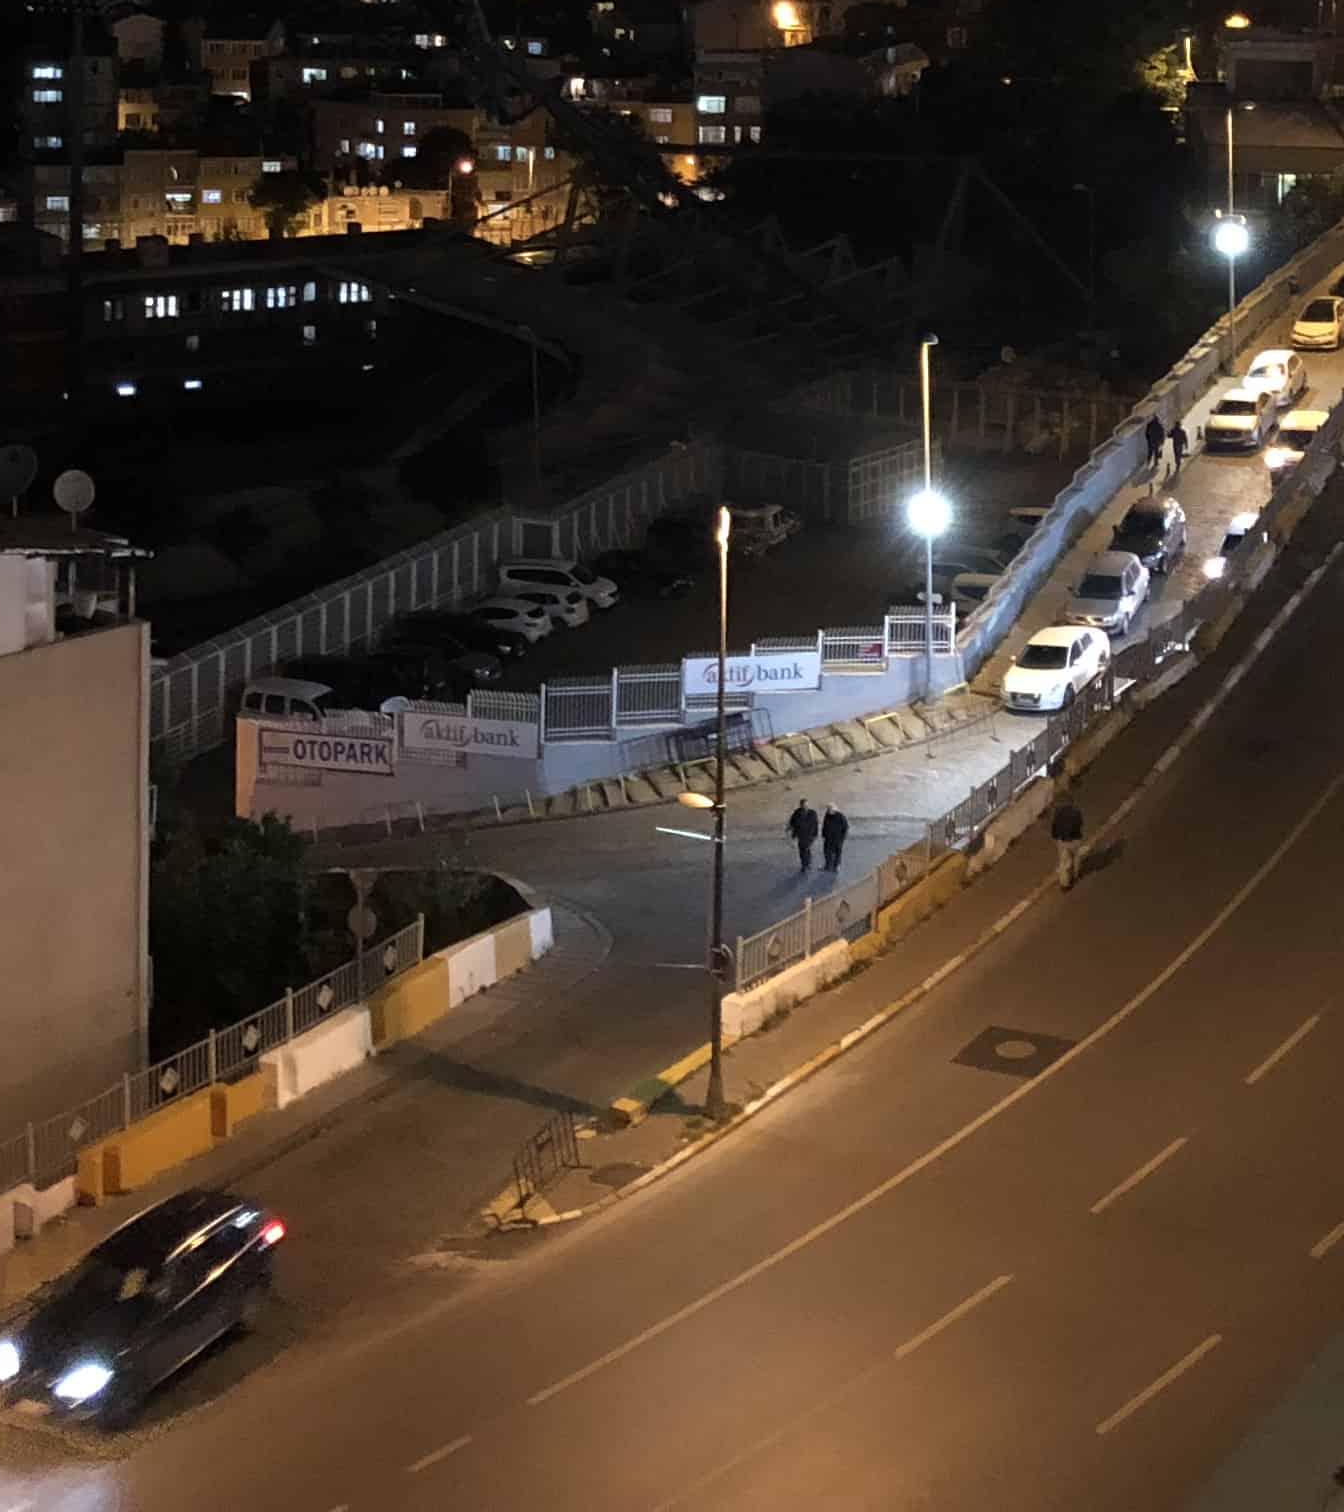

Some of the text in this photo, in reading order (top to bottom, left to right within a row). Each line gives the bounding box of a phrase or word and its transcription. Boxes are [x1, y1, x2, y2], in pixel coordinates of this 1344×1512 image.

[704, 663, 804, 686] atif bank
[474, 727, 520, 747] bank
[294, 739, 388, 764] OTOPARK
